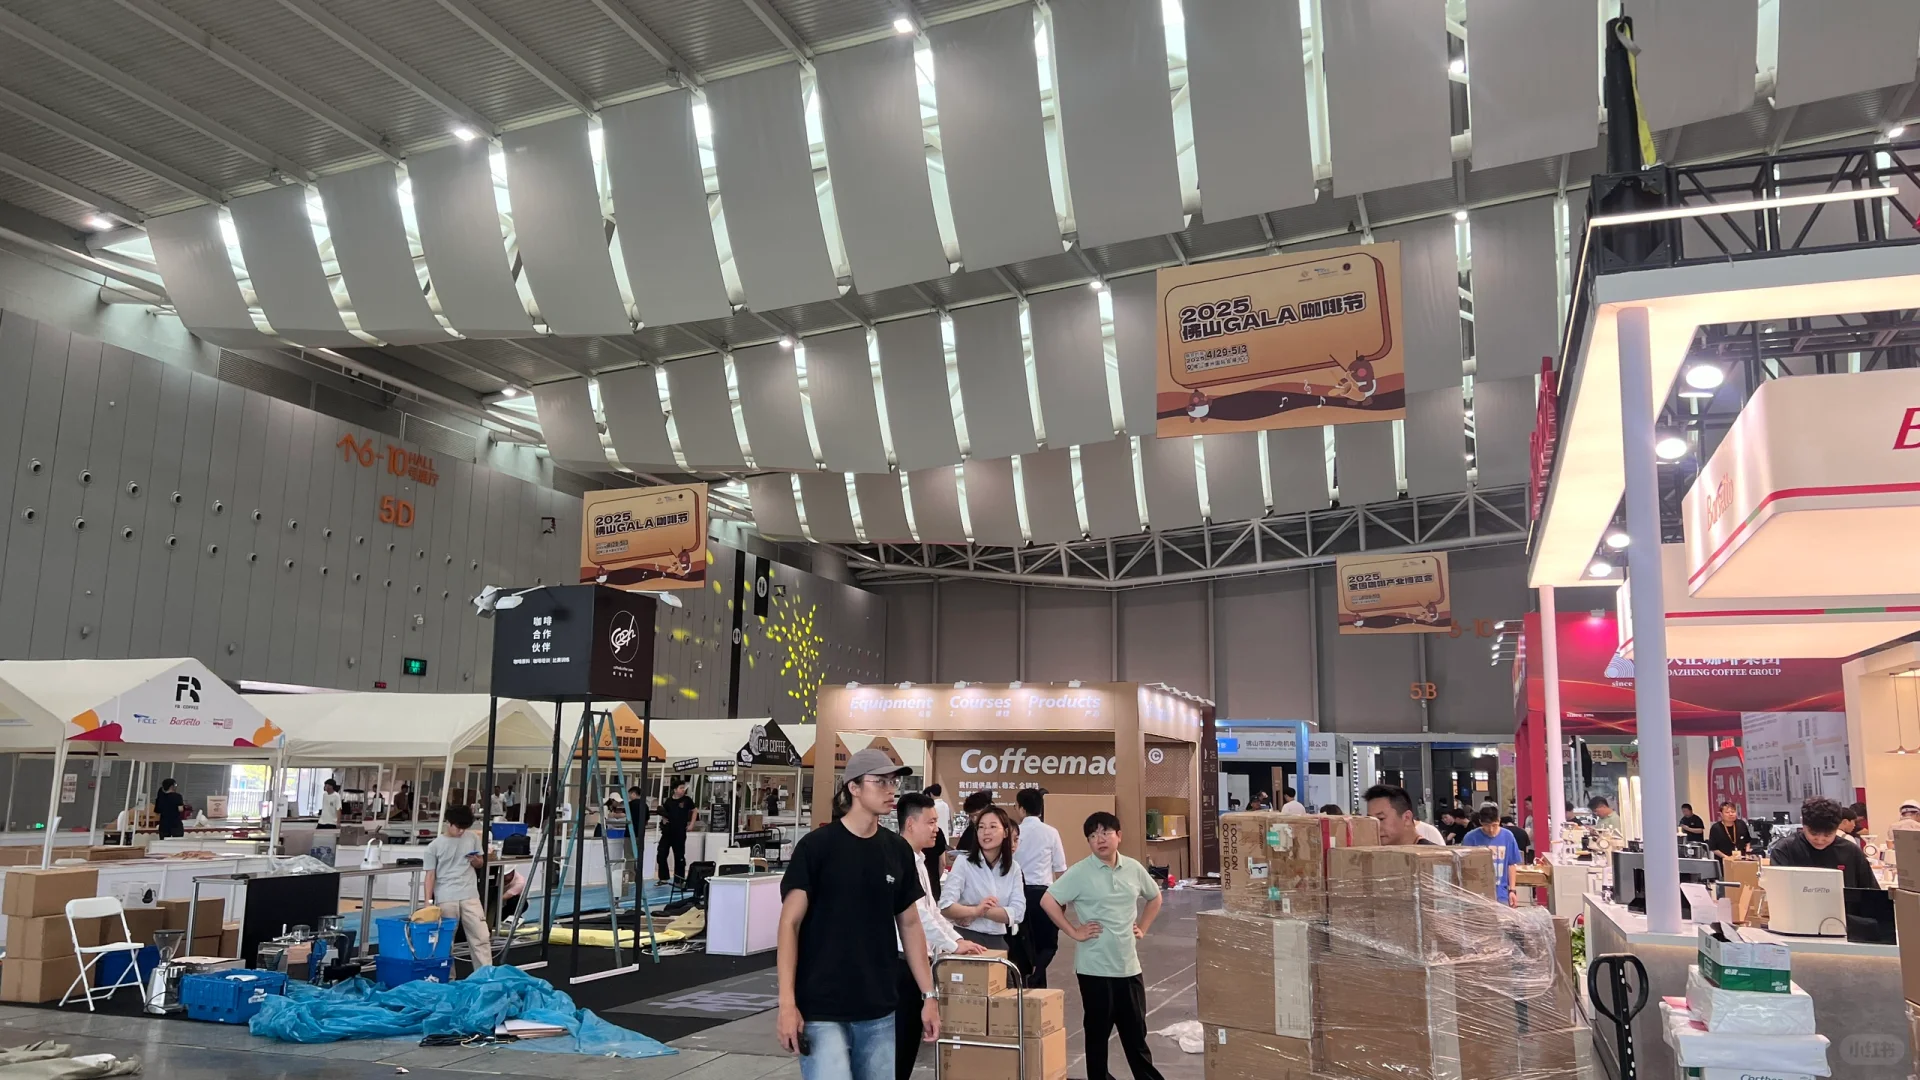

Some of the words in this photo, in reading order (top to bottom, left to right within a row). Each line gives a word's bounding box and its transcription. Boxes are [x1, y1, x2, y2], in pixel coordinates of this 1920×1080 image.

[1181, 297, 1250, 324] 2025
[1182, 306, 1298, 340] 佛山GALA
[1300, 293, 1364, 319] 咖啡节
[379, 495, 415, 527] 5D
[595, 512, 631, 526] 2025
[656, 512, 688, 526] 咖啡节
[1348, 574, 1380, 583] 2025
[533, 616, 552, 626] 咖啡
[532, 629, 552, 640] 合作
[532, 642, 551, 653] 伙伴
[1711, 668, 1747, 676] COFFEE
[1749, 668, 1782, 676] GROUP
[1410, 682, 1437, 699] 5B
[850, 696, 933, 712] Equipment
[949, 695, 1012, 709] Courses
[1028, 694, 1101, 709] Products
[759, 738, 769, 752] CAR
[770, 740, 786, 753] COFFEE
[1222, 823, 1230, 855] COFFEE
[1231, 855, 1239, 871] ON
[1223, 857, 1231, 890] LOVERS
